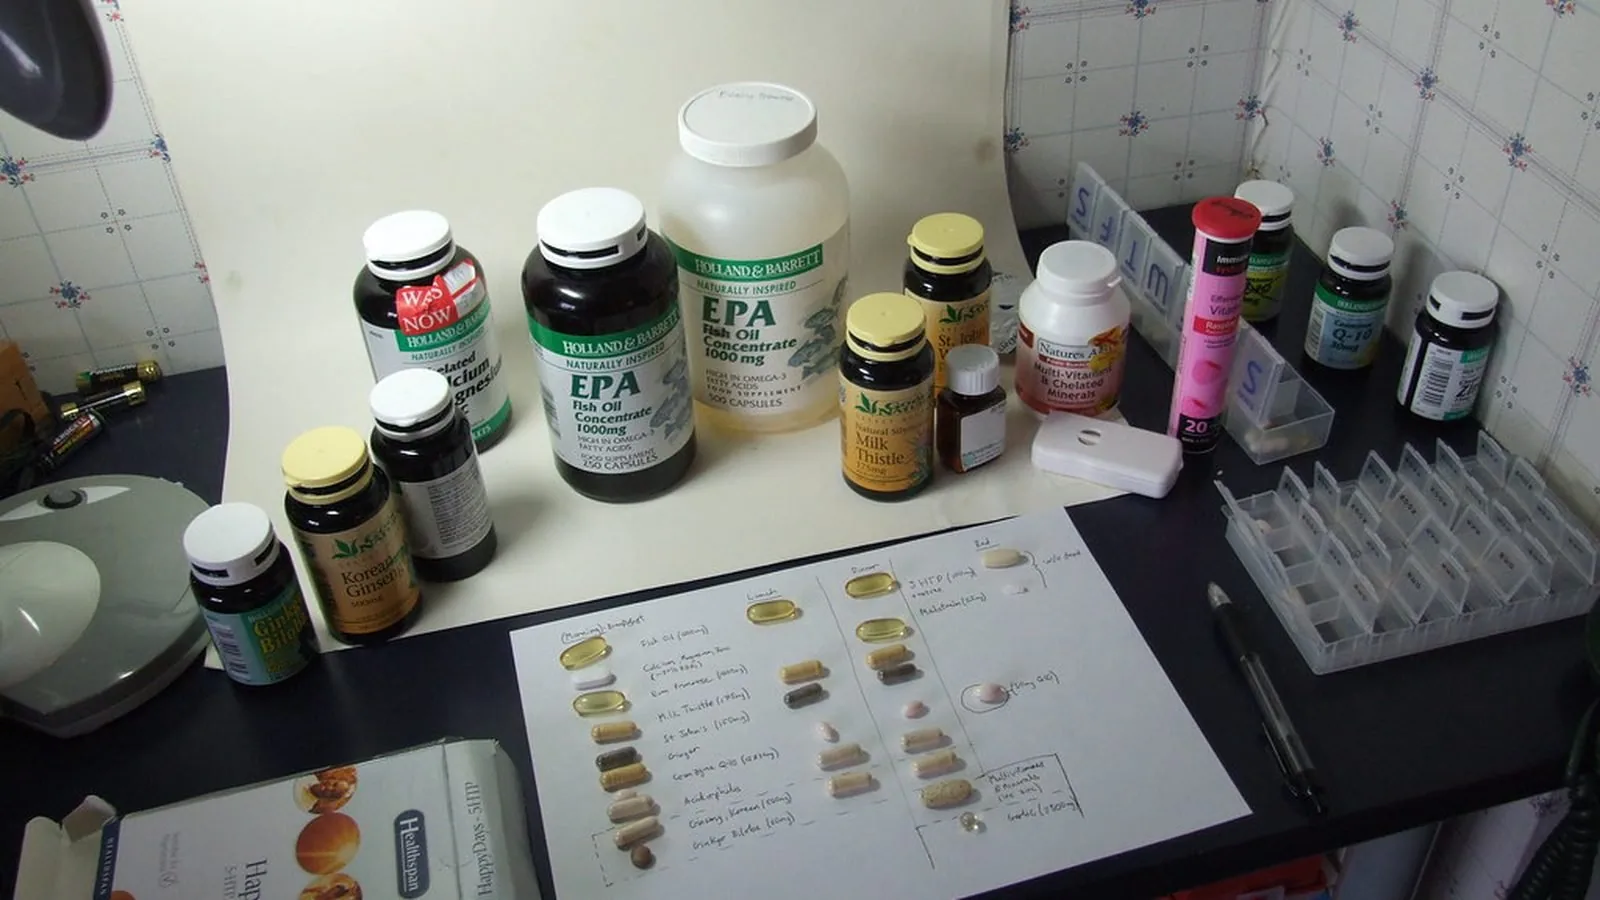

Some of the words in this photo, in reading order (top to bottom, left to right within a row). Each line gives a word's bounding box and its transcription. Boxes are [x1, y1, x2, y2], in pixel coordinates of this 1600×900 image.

[695, 258, 751, 277] HOLLAND
[751, 264, 764, 278] &
[765, 249, 822, 275] BARRETT
[401, 282, 444, 308] WAS
[697, 279, 749, 295] NATURALLY
[752, 280, 797, 295] INSPIRED
[402, 306, 451, 333] NOW
[702, 296, 776, 327] EPA
[407, 329, 455, 349] HOLLAND
[563, 339, 623, 355] HOLLAND
[623, 336, 637, 350] &
[637, 313, 681, 346] BARRETT
[703, 324, 731, 339] Fish
[735, 328, 760, 341] Oil
[1332, 328, 1374, 342] Q-10
[411, 344, 457, 361] NATURALLY
[703, 335, 797, 353] Concentrate
[1040, 341, 1086, 360] Natures
[566, 358, 623, 372] NATURALLY
[625, 341, 666, 367] INSPIRED
[705, 347, 738, 363] 1000
[740, 353, 765, 367] mg
[705, 368, 728, 381] HIGH
[729, 372, 741, 382] IN
[706, 376, 730, 388] FATTY
[731, 380, 758, 391] ACIDS
[1052, 378, 1104, 390] Chelated
[570, 370, 641, 401] EPA
[707, 384, 732, 396] FOOD
[737, 385, 802, 398] SUPPLEMENT
[1047, 387, 1097, 400] Minerals
[573, 400, 597, 413] Fish
[602, 400, 622, 412] Oil
[729, 397, 782, 409] CAPSULES
[574, 406, 653, 425] Concentrate
[577, 423, 628, 437] 1000mg
[856, 423, 889, 437] Natural
[1185, 418, 1208, 434] 20
[577, 435, 600, 445] HIGH
[579, 443, 602, 453] FATTY
[604, 444, 632, 453] ACIDS
[856, 431, 889, 451] Milk
[580, 452, 603, 463] FOOD
[604, 448, 655, 464] SUPPLEMENT
[604, 453, 658, 471] CAPSULES
[856, 447, 905, 467] Thistle
[341, 557, 395, 586] Korean
[345, 568, 403, 598] Ginseng
[400, 816, 421, 893] Healthspan
[472, 822, 496, 896] HappyDays
